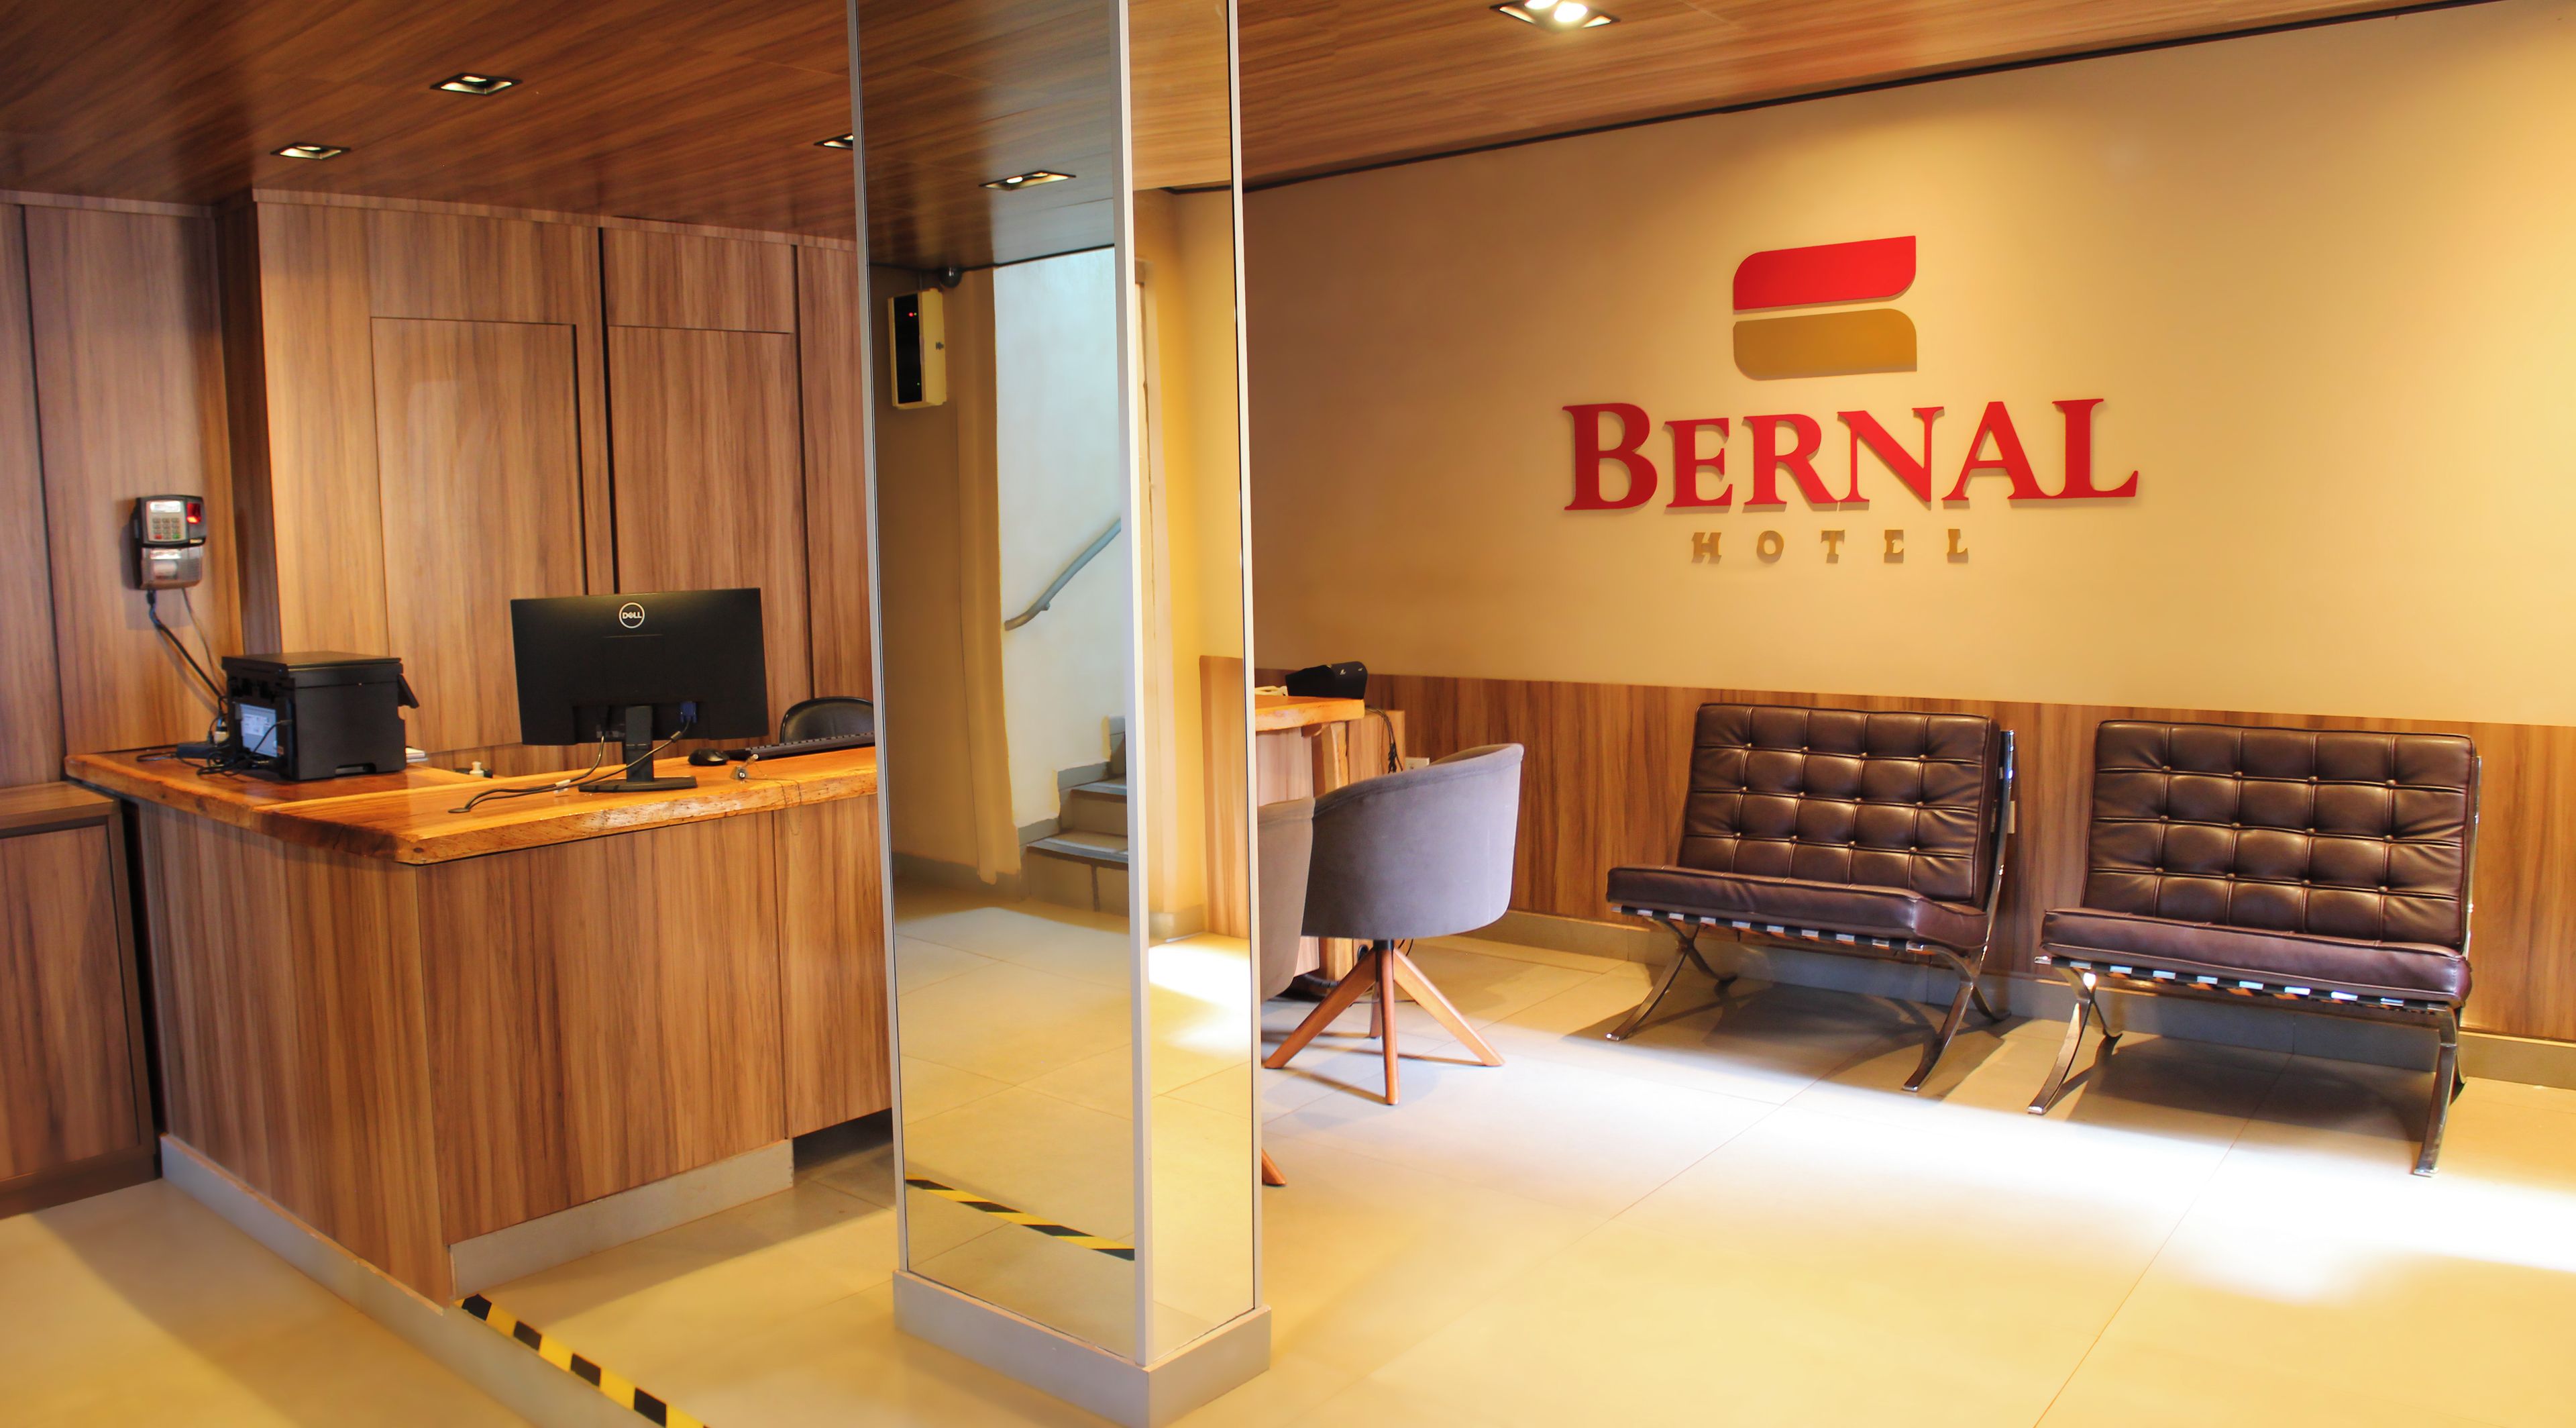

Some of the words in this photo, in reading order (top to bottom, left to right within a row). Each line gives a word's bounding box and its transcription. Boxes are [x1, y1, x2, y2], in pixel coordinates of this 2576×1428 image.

[1562, 397, 2139, 511] BERNAL
[1691, 528, 1969, 562] HOTEL
[622, 611, 643, 619] DELL
